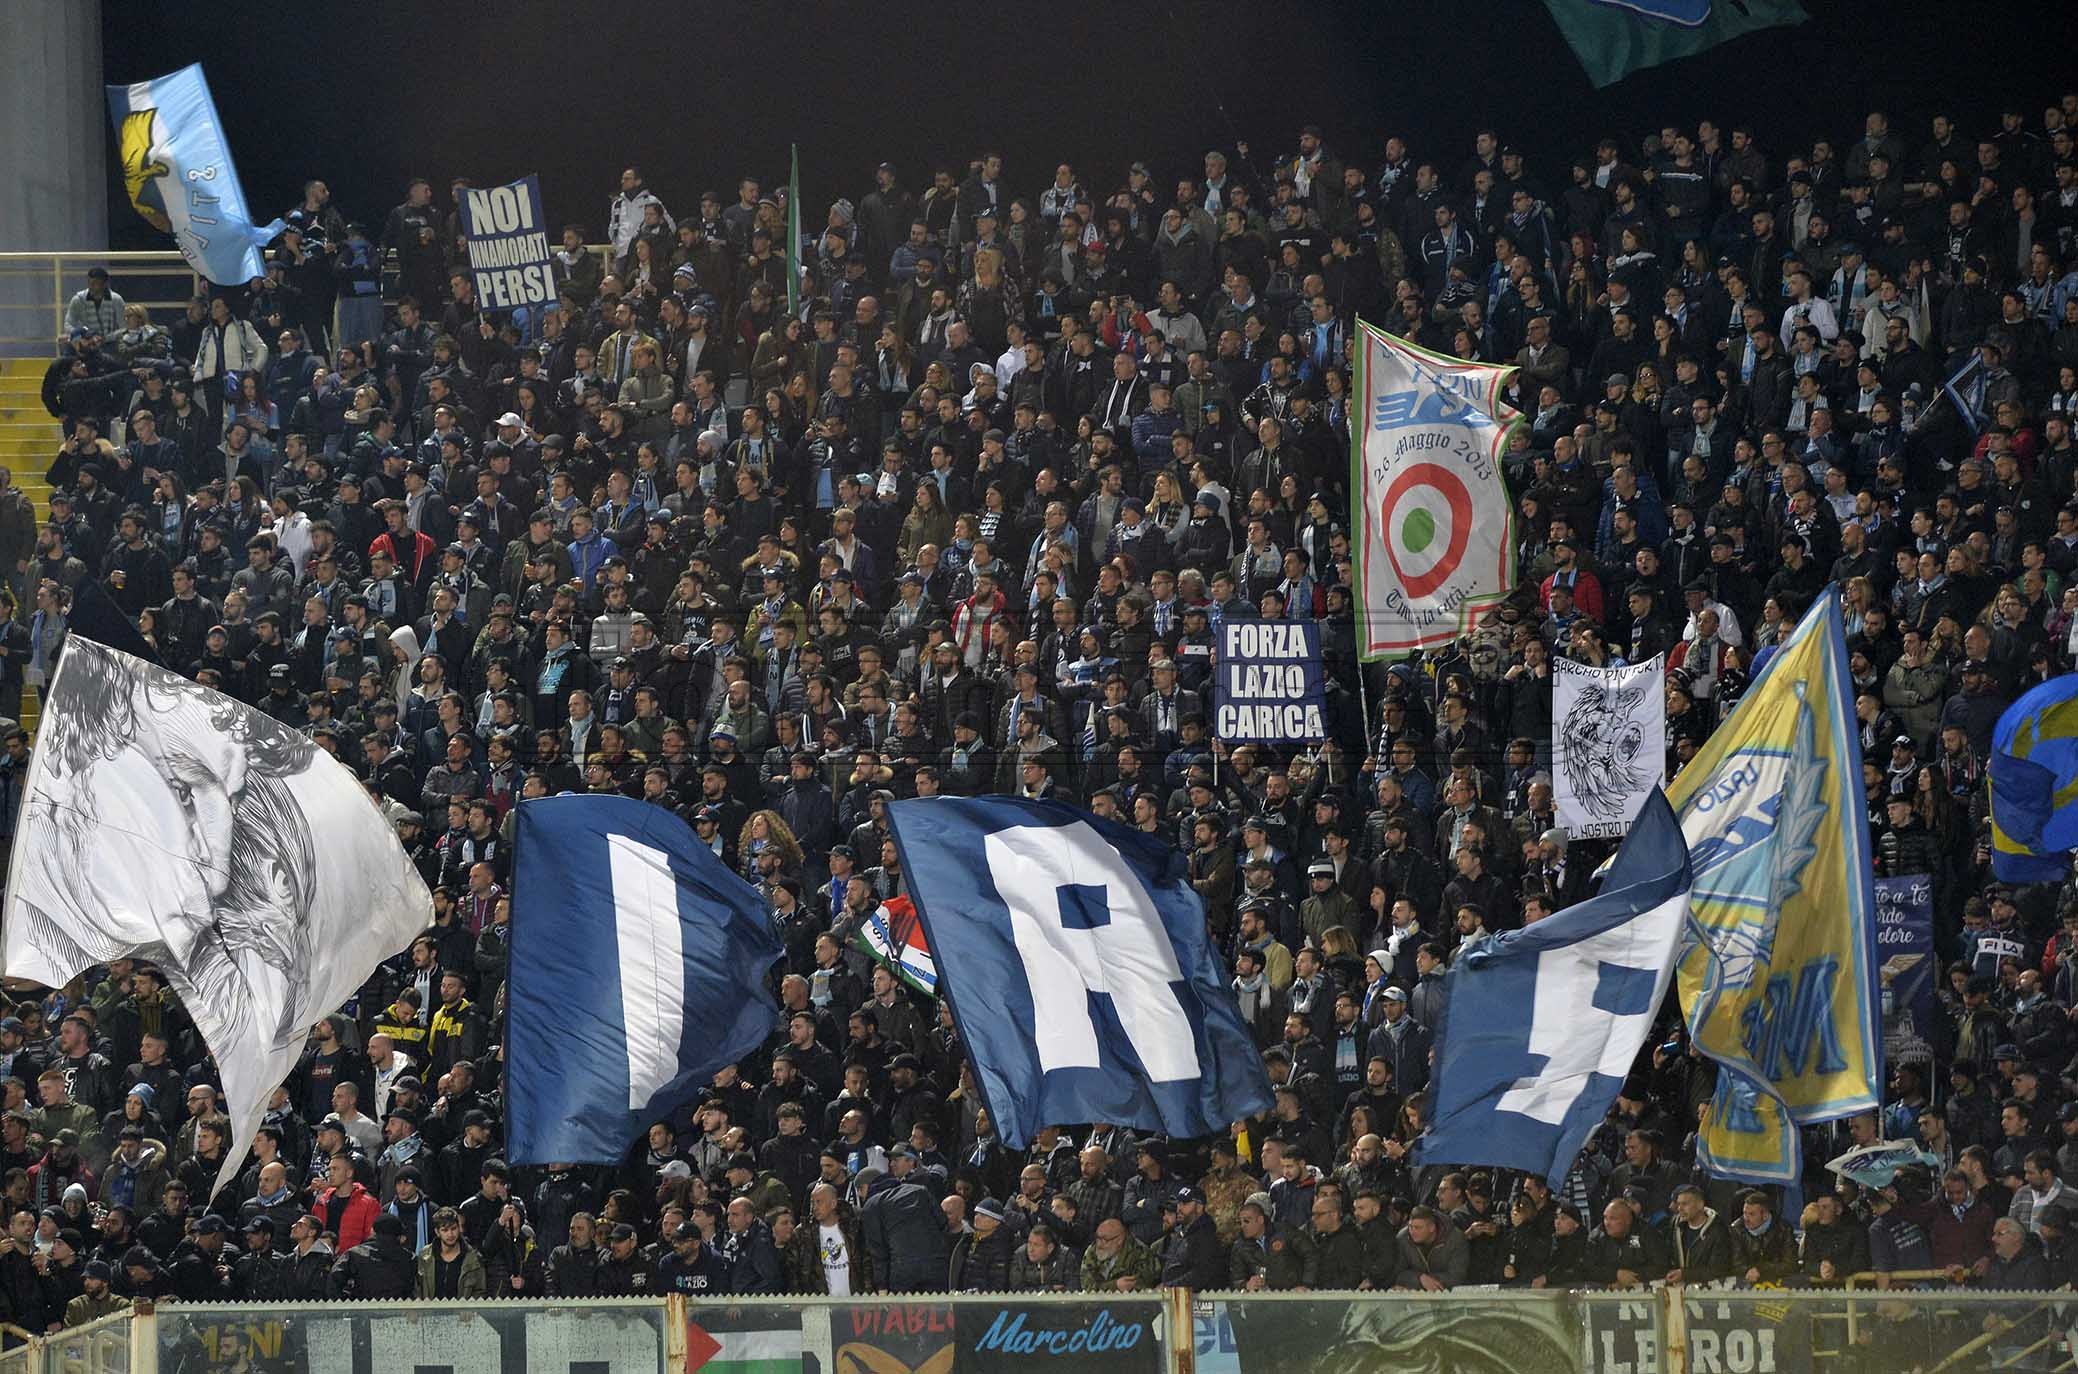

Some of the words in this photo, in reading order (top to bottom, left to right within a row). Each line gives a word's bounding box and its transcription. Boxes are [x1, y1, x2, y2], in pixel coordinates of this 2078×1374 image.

[467, 184, 533, 235] NOI
[468, 232, 549, 268] INNAMORATI
[476, 264, 556, 308] PERSI
[1227, 623, 1308, 658] FORZA
[1231, 665, 1304, 698] LAZIO
[1218, 704, 1324, 738] CARICA
[983, 819, 1201, 1083] R
[1878, 926, 1915, 944] olore
[1985, 940, 2018, 954] FILA
[975, 1305, 1142, 1355] Marcolino
[1690, 1328, 1777, 1374] ROI
